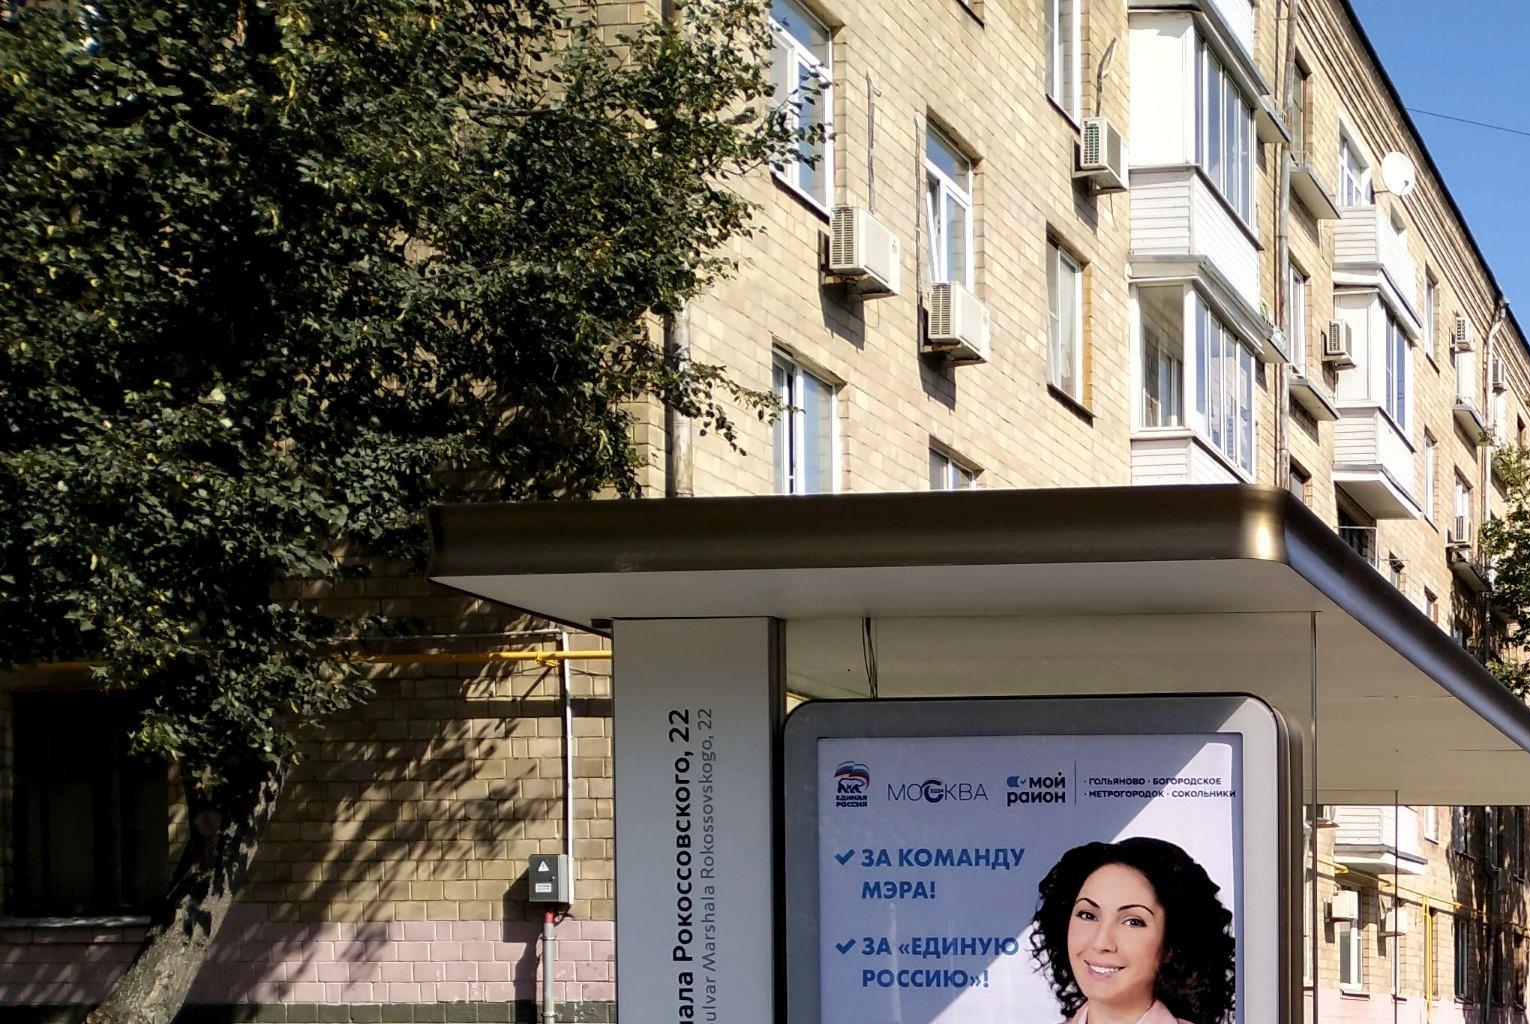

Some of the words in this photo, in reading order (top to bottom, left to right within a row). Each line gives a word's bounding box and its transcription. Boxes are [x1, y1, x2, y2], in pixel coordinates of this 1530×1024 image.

[668, 709, 690, 743] 22
[697, 708, 713, 730] 22
[887, 777, 989, 803] МОСКВА
[1029, 772, 1066, 790] мой
[1089, 776, 1146, 786] ГОЛЬЯНОВО
[1153, 776, 1222, 786] БОГОРОДСКОЕ
[1089, 789, 1164, 799] МЕТРОГОРОДОК
[1171, 789, 1236, 799] СОКОЛЬНИКИ
[699, 735, 719, 879] Rokossovskogo,
[670, 751, 695, 961] Рокоссовского,
[861, 848, 892, 868] ЗА
[898, 848, 1025, 871] КОМАНДУ
[861, 880, 936, 900] МЭРА!
[701, 886, 717, 971] Marshala
[861, 937, 892, 956] ЗА
[899, 937, 1020, 959] «ЕДИНУЮ
[862, 969, 989, 989] РОССИЮ»!
